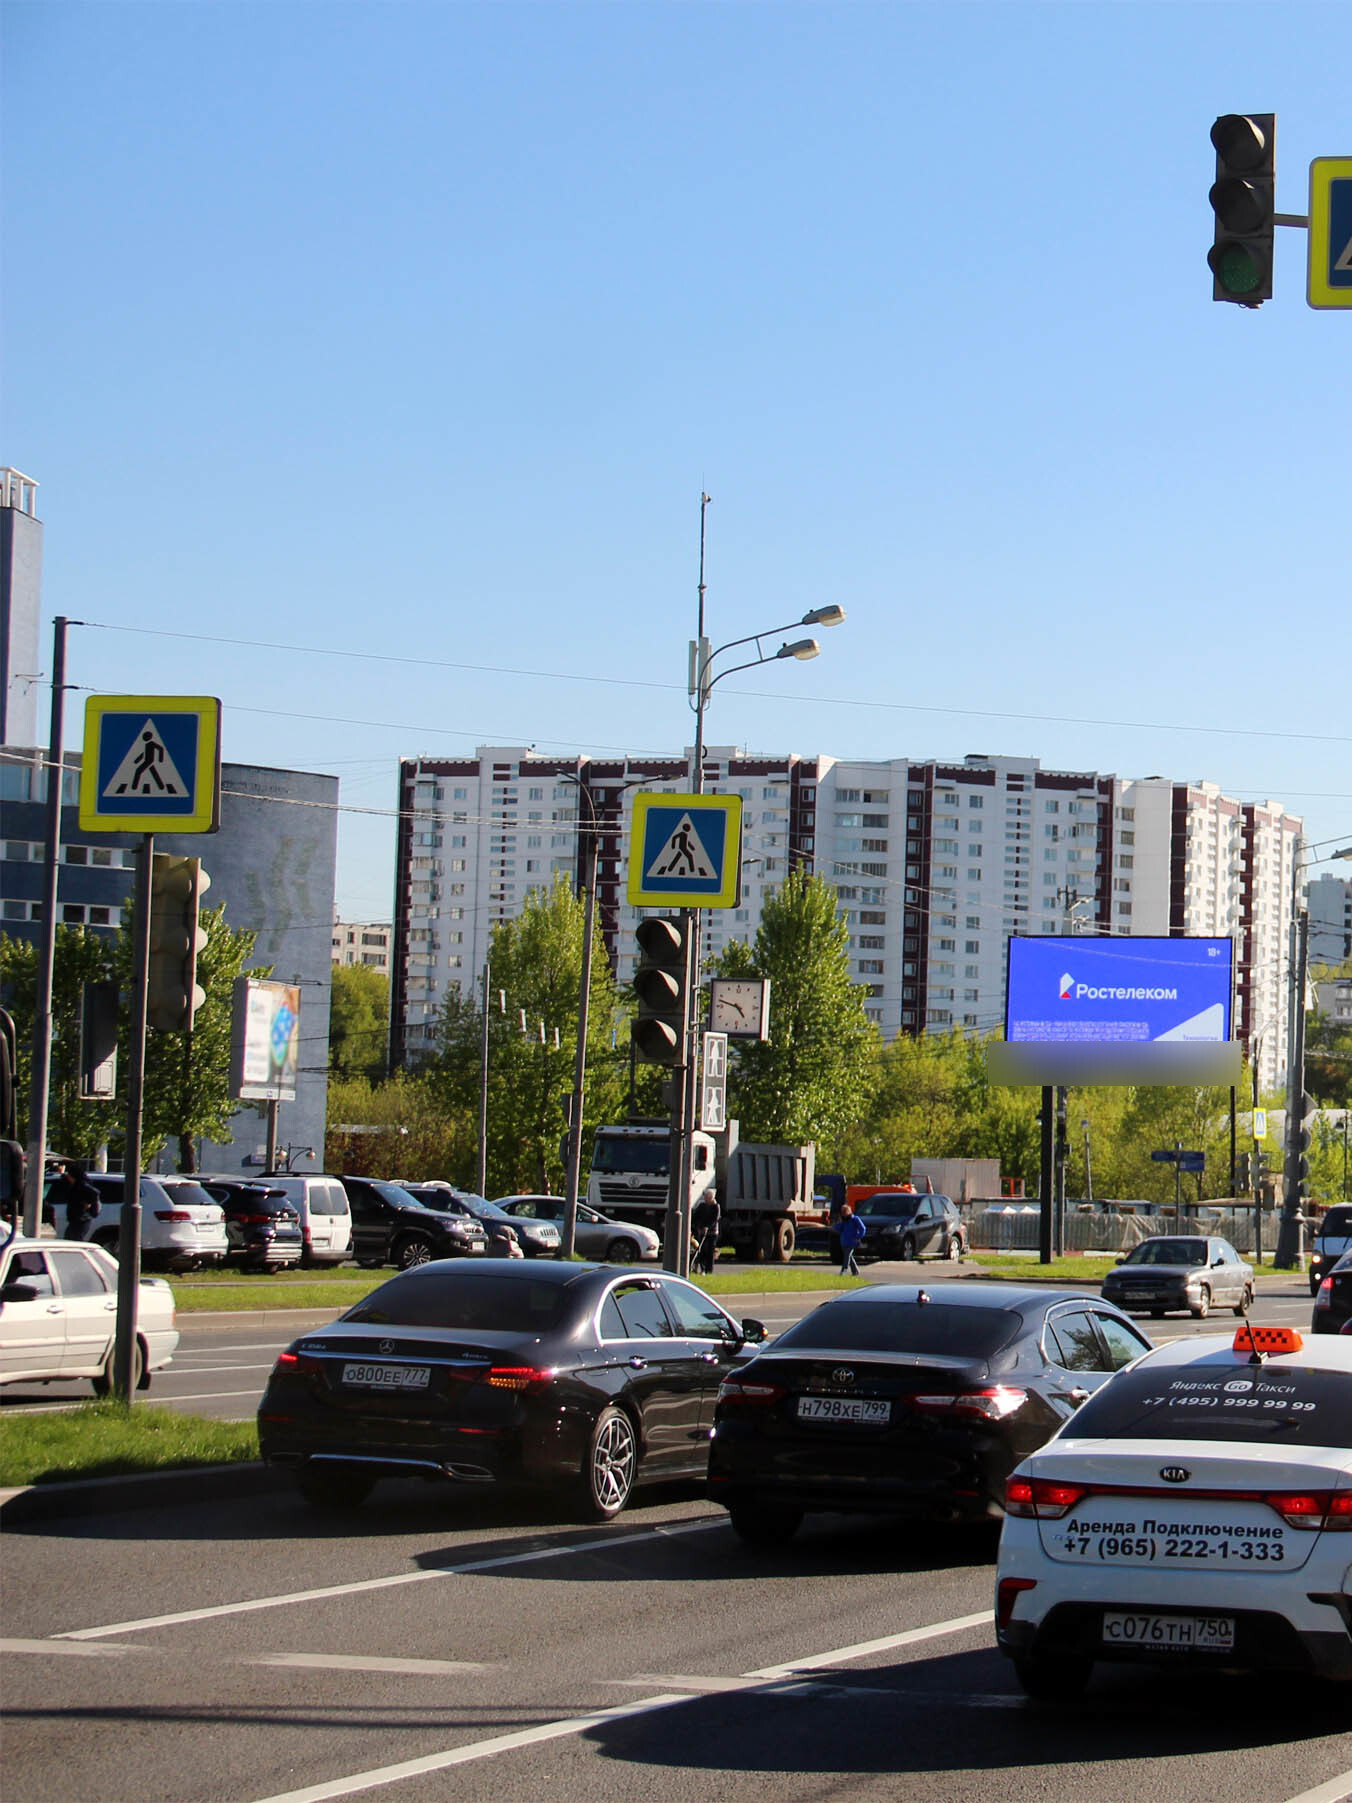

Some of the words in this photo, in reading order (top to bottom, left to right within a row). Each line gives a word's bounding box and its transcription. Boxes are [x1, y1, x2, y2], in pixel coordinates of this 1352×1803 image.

[1207, 947, 1222, 957] 18+
[1076, 983, 1177, 1000] Ростелеком
[1169, 1380, 1222, 1391] Яндекс
[1255, 1382, 1296, 1394] Такси
[802, 1399, 861, 1418] Н798ХЕ
[863, 1401, 888, 1415] 799
[1142, 1397, 1166, 1406] +7
[1168, 1396, 1219, 1407] (495)
[1223, 1398, 1259, 1408] 999
[1263, 1399, 1288, 1409] 99
[1291, 1401, 1317, 1411] 99
[1163, 1469, 1186, 1479] KIA
[1066, 1519, 1136, 1536] Аренда
[1143, 1519, 1284, 1539] Подключение
[1064, 1537, 1091, 1555] +7
[1098, 1537, 1157, 1561] (965)
[1164, 1538, 1285, 1561] 222-1-333
[1109, 1616, 1192, 1642] С076ТН
[1198, 1619, 1229, 1637] 750
